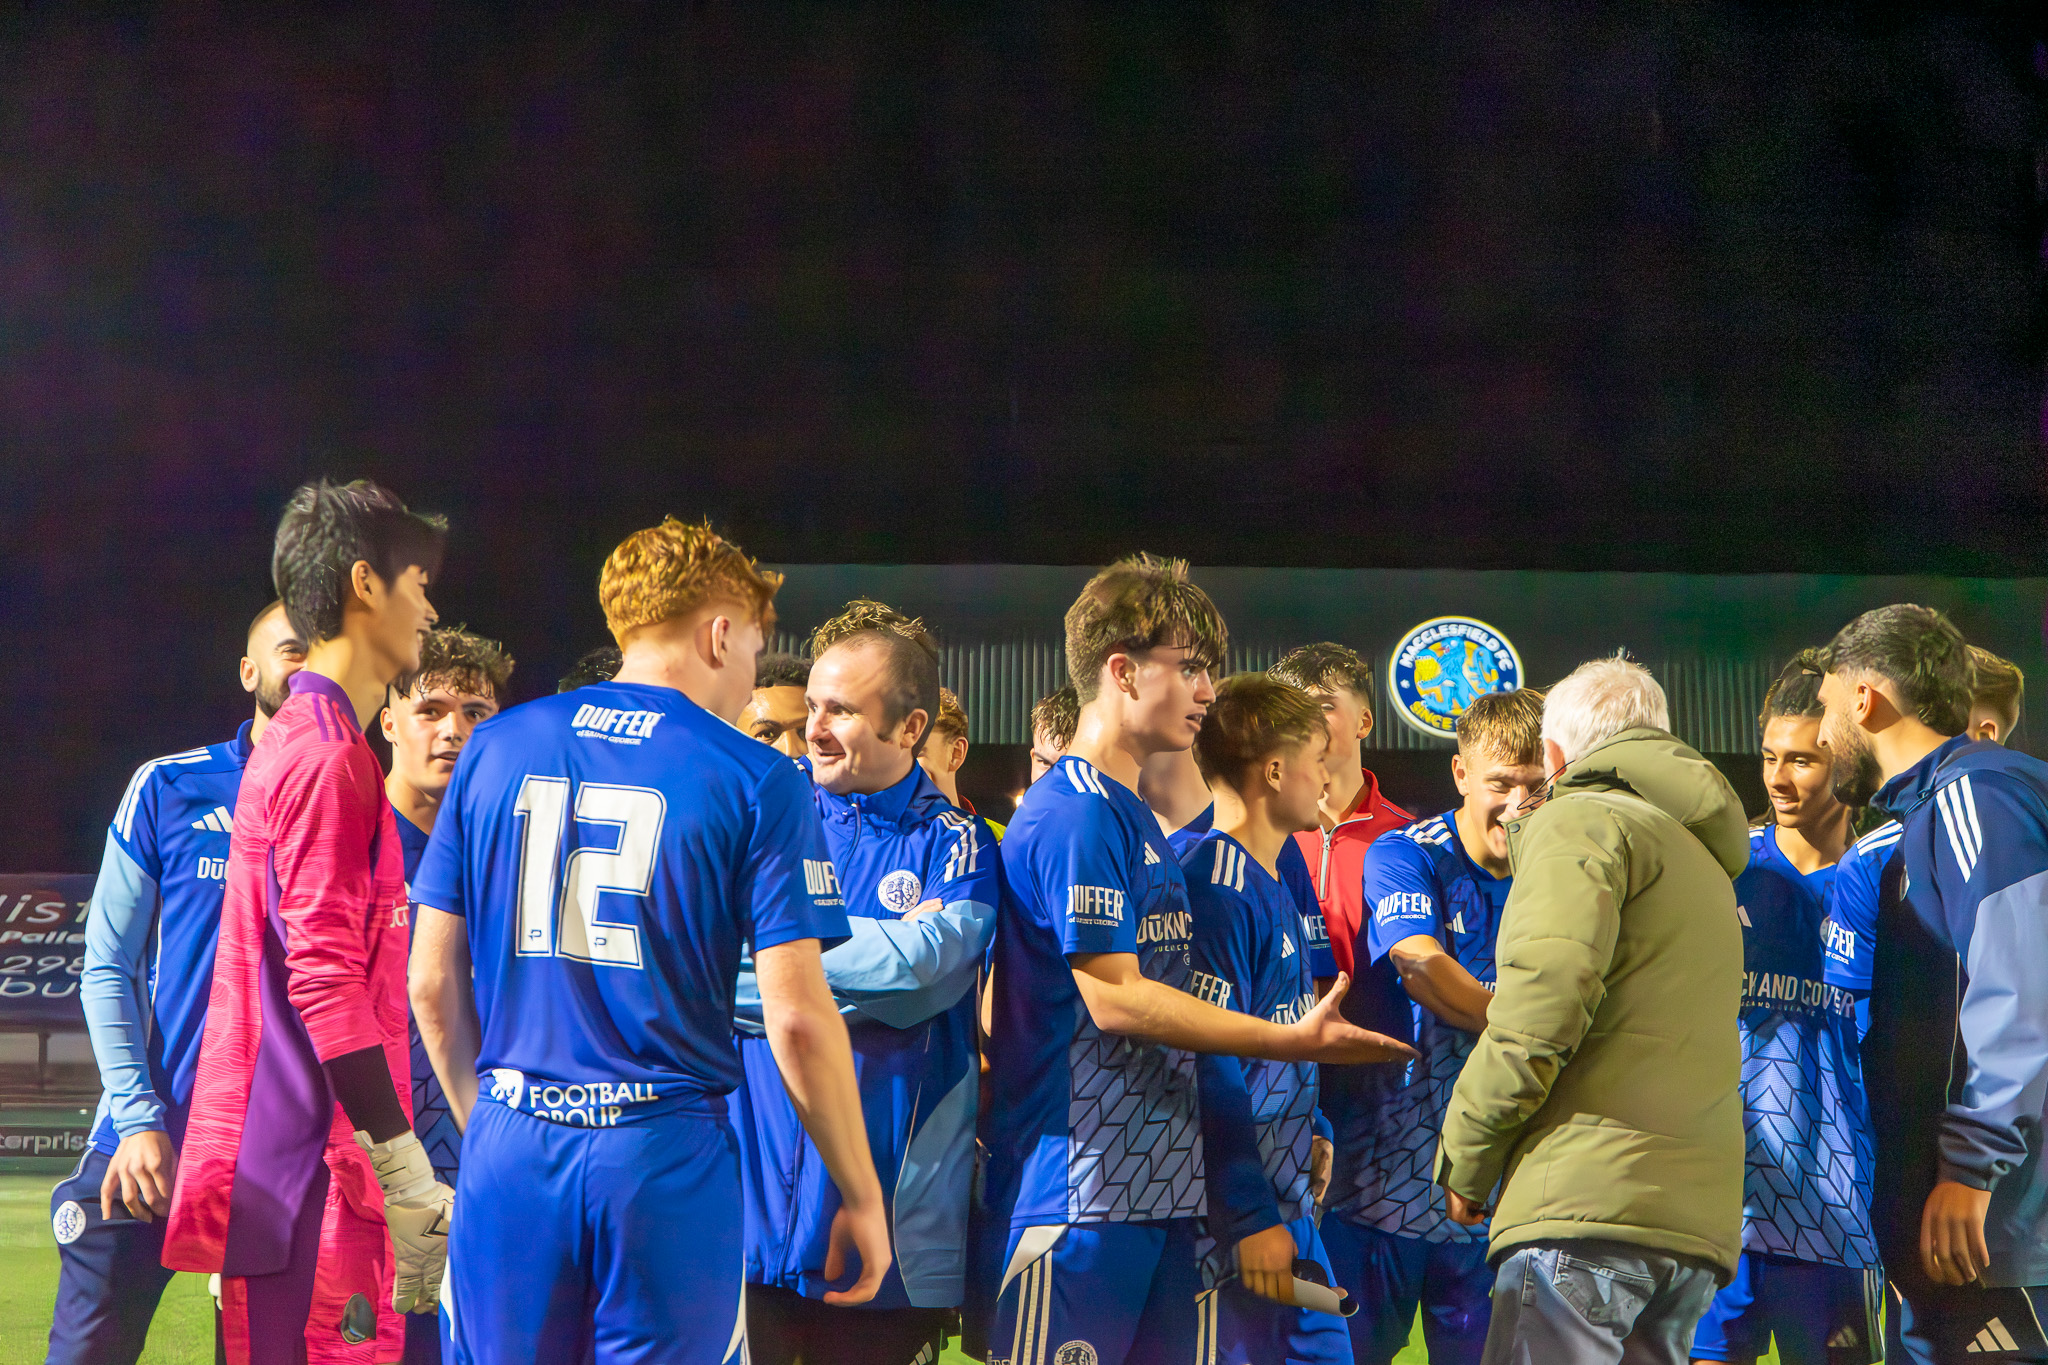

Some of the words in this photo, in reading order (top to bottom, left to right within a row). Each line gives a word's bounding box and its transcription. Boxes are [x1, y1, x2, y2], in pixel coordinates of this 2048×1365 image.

[1399, 624, 1501, 668] MACCLESFIELD
[1494, 650, 1514, 672] FC
[571, 703, 661, 739] DUFFER
[1409, 700, 1454, 730] SINCE
[513, 774, 667, 970] 12
[1066, 884, 1125, 921] DUFFER
[1376, 891, 1432, 923] DUFFER
[1801, 979, 1855, 1018] COVER
[529, 1082, 659, 1109] FOOTBALL
